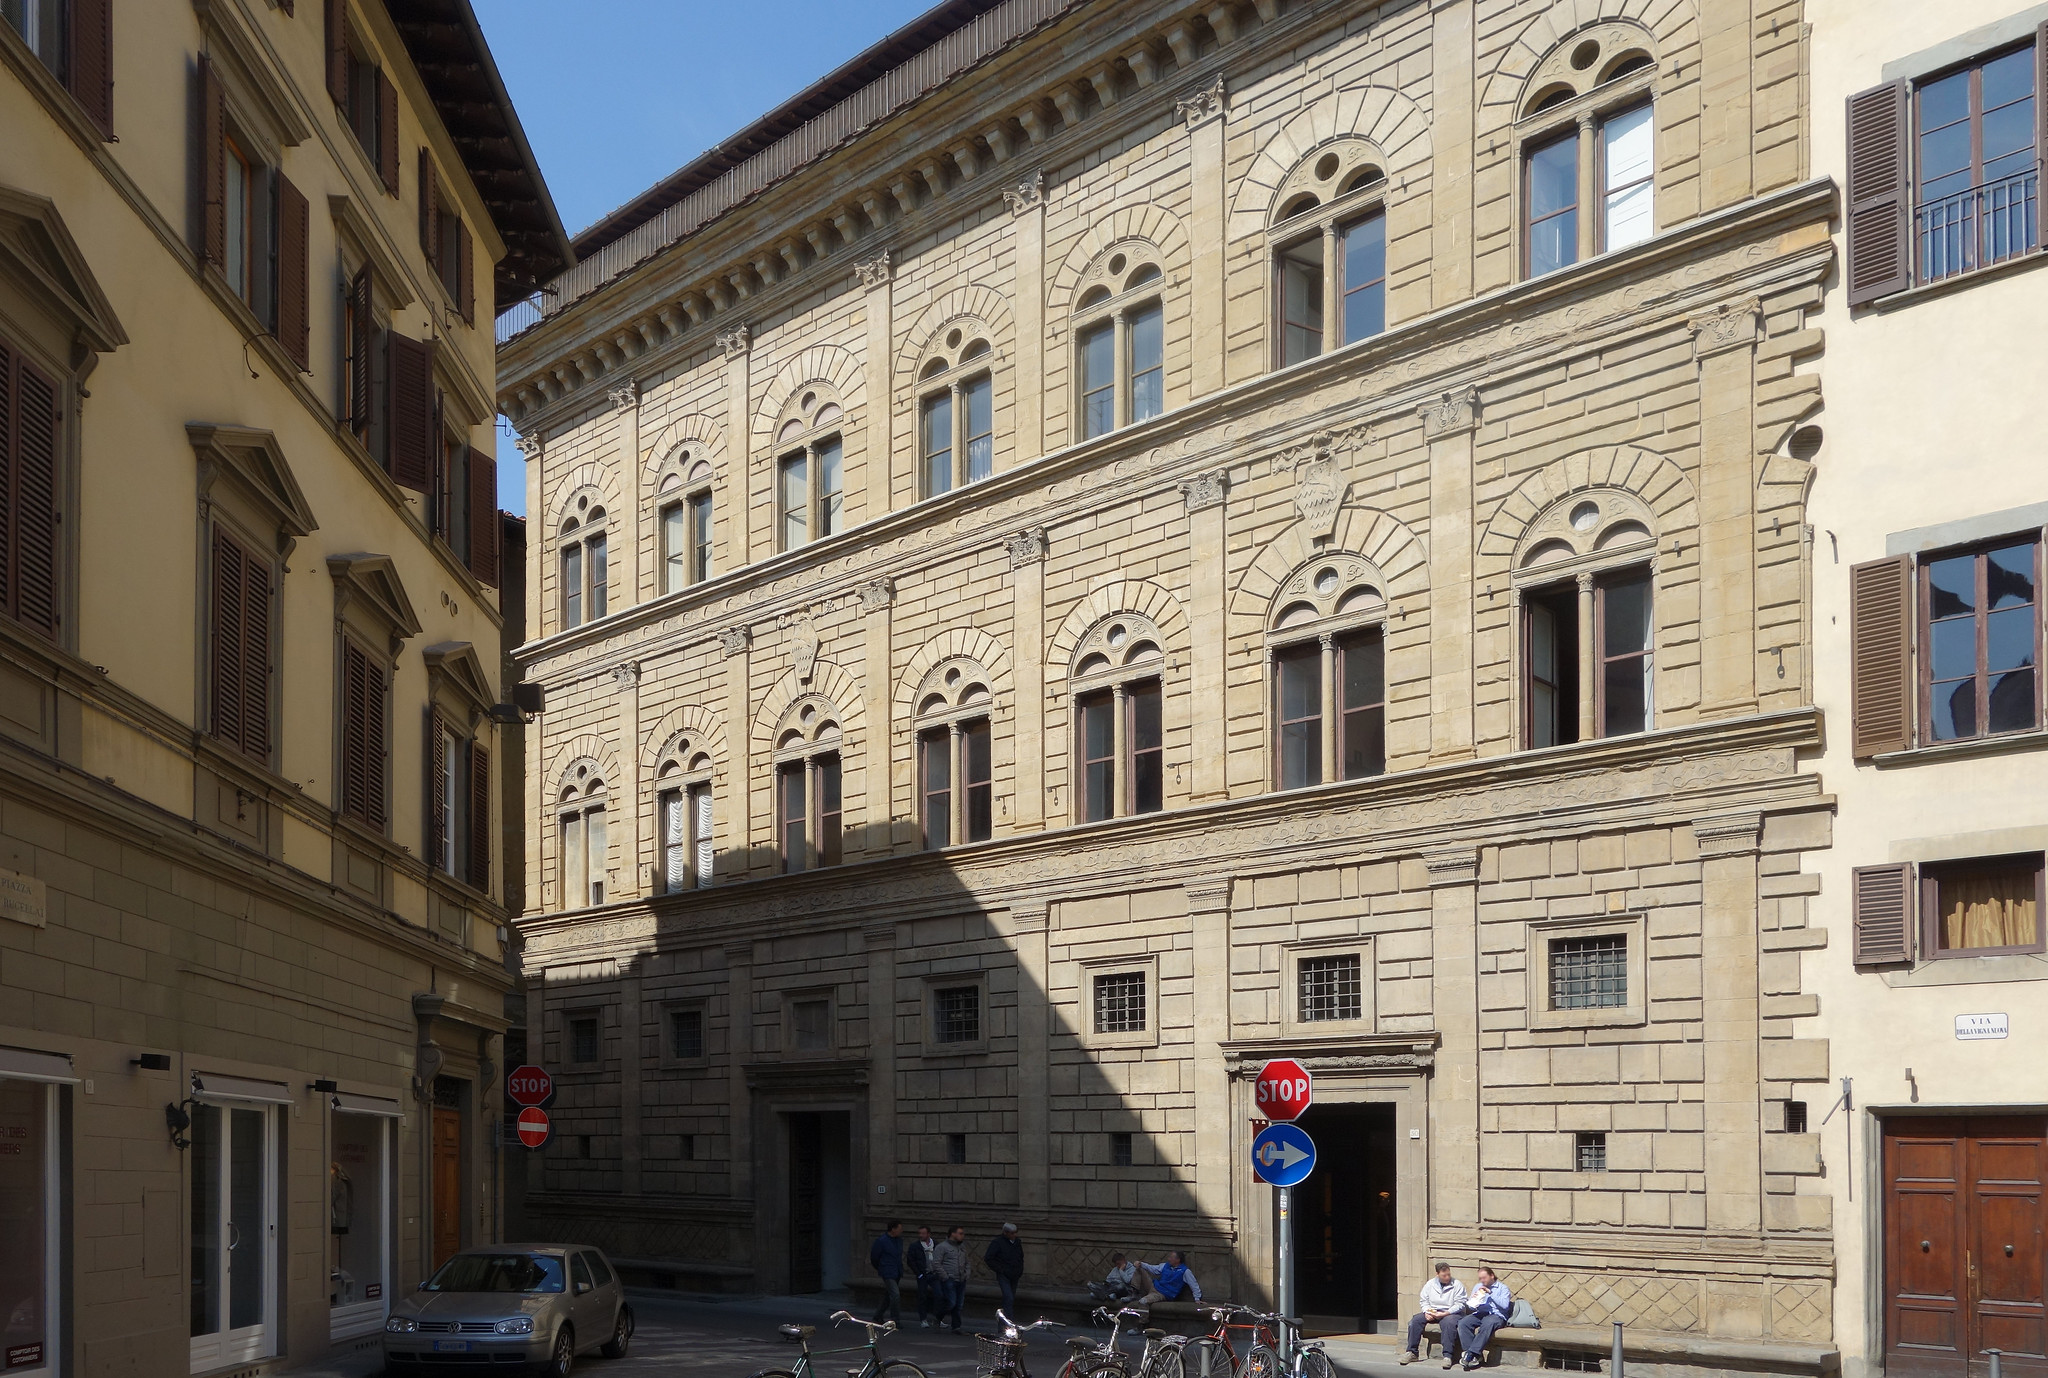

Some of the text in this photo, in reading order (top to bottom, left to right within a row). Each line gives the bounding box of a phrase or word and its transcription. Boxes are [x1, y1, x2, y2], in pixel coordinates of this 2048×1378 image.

[1, 878, 32, 895] PIAZZA
[512, 1078, 549, 1093] STOP
[1258, 1078, 1308, 1102] STOP
